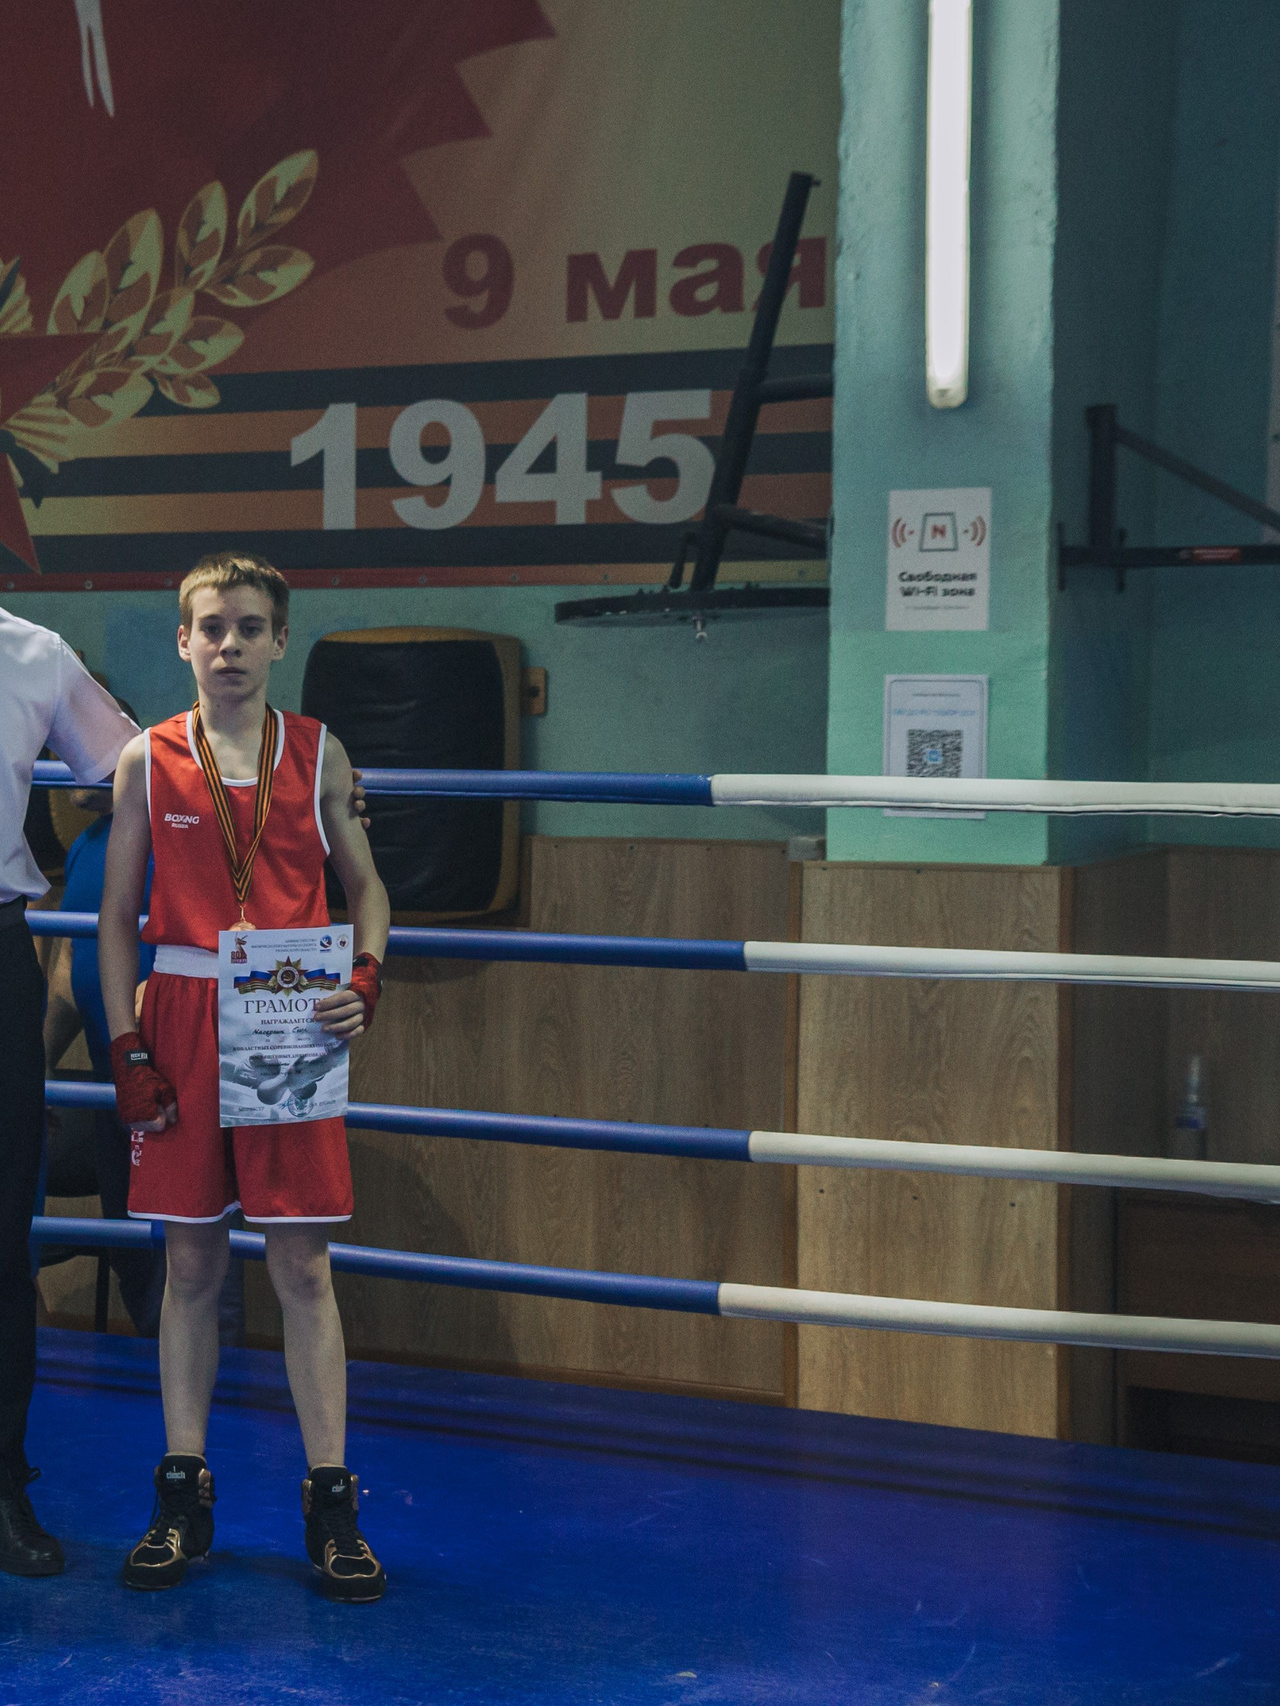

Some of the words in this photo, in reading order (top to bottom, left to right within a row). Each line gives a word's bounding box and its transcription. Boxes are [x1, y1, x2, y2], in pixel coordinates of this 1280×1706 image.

[442, 233, 514, 330] 9
[566, 236, 827, 323] мая
[291, 389, 717, 530] 1945
[898, 571, 978, 582] Свободная
[942, 588, 976, 597] зона
[244, 998, 321, 1014] ГРАМОТ
